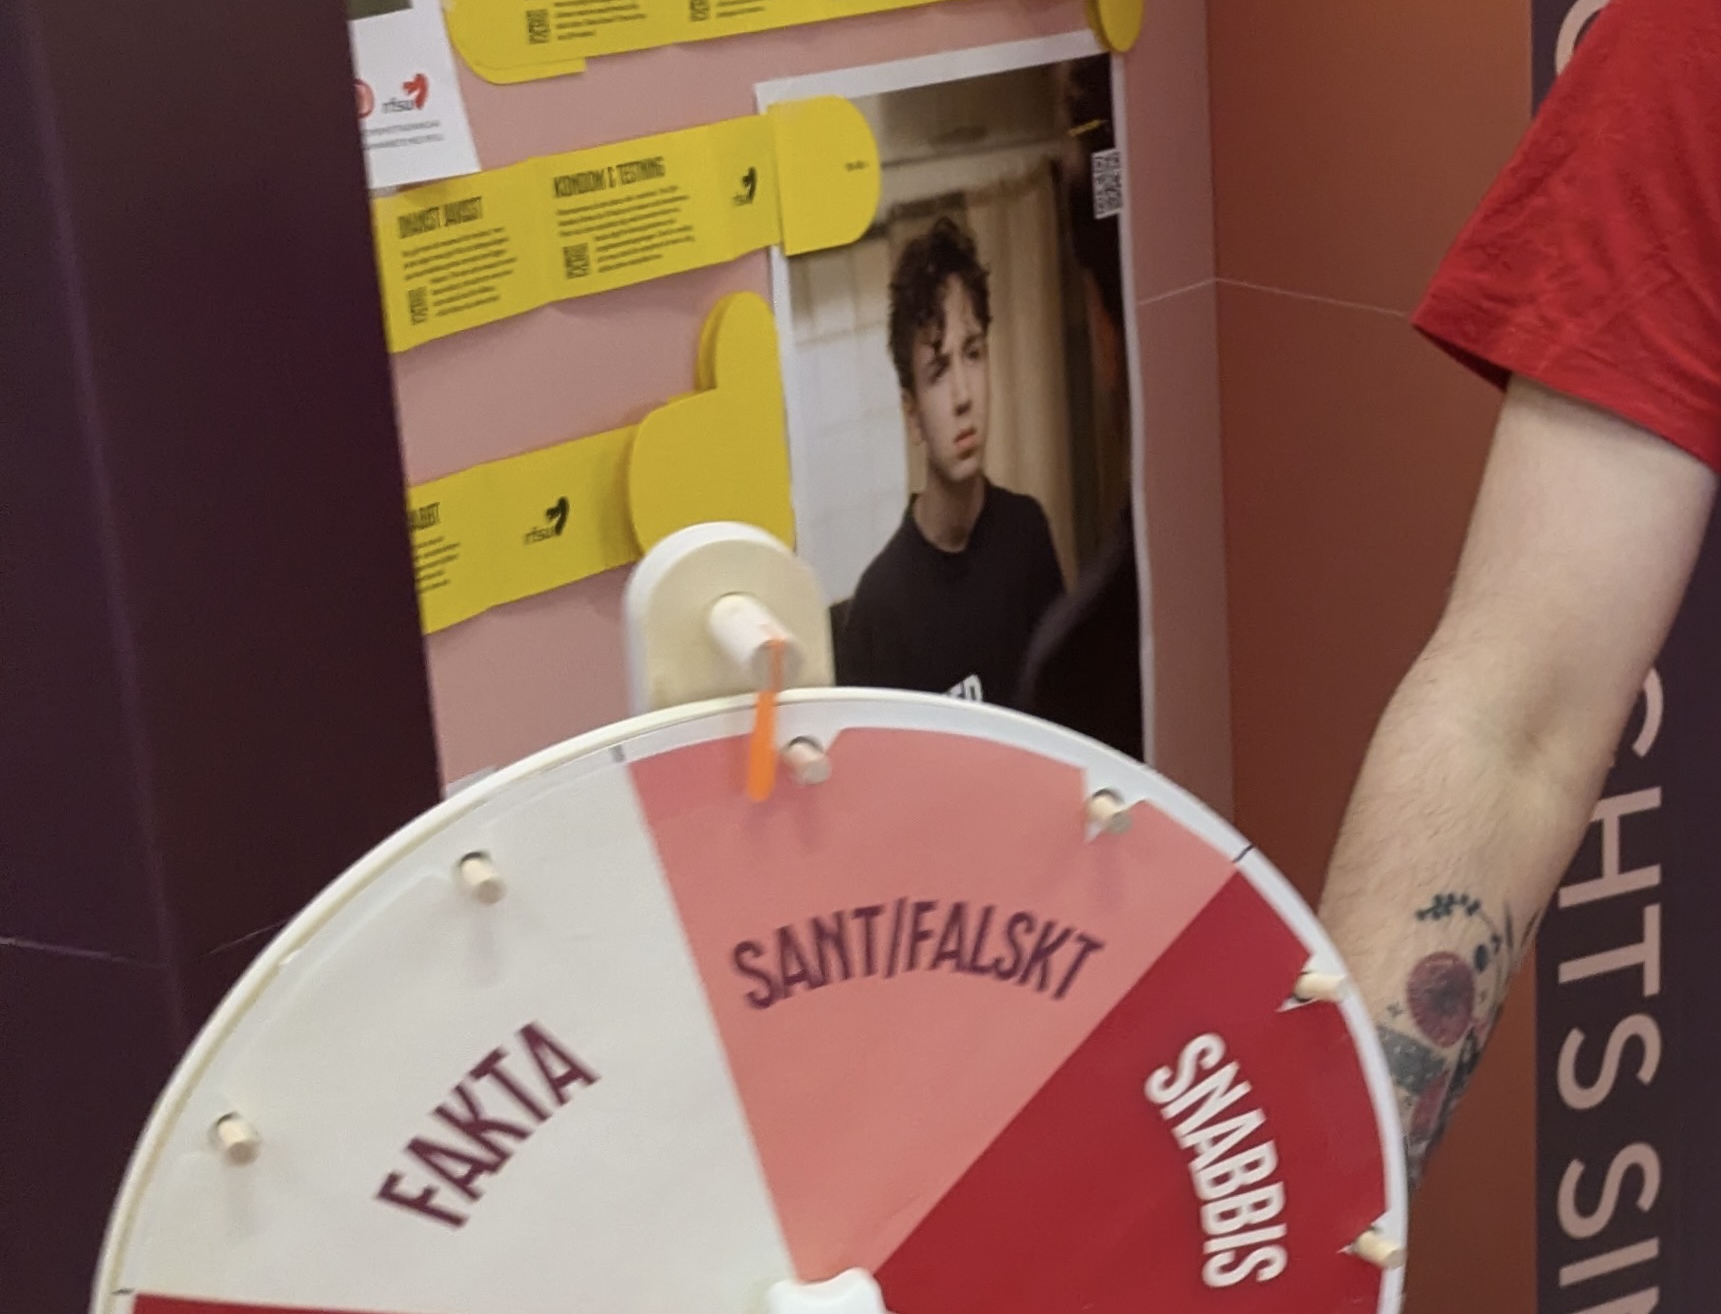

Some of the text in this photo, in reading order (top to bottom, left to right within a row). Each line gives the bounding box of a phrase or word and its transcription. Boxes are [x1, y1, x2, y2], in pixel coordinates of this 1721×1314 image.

[730, 896, 1107, 1012] SANT/FALSKT
[375, 1022, 601, 1230] FAKTA
[1144, 1032, 1288, 1289] SNABBIS
